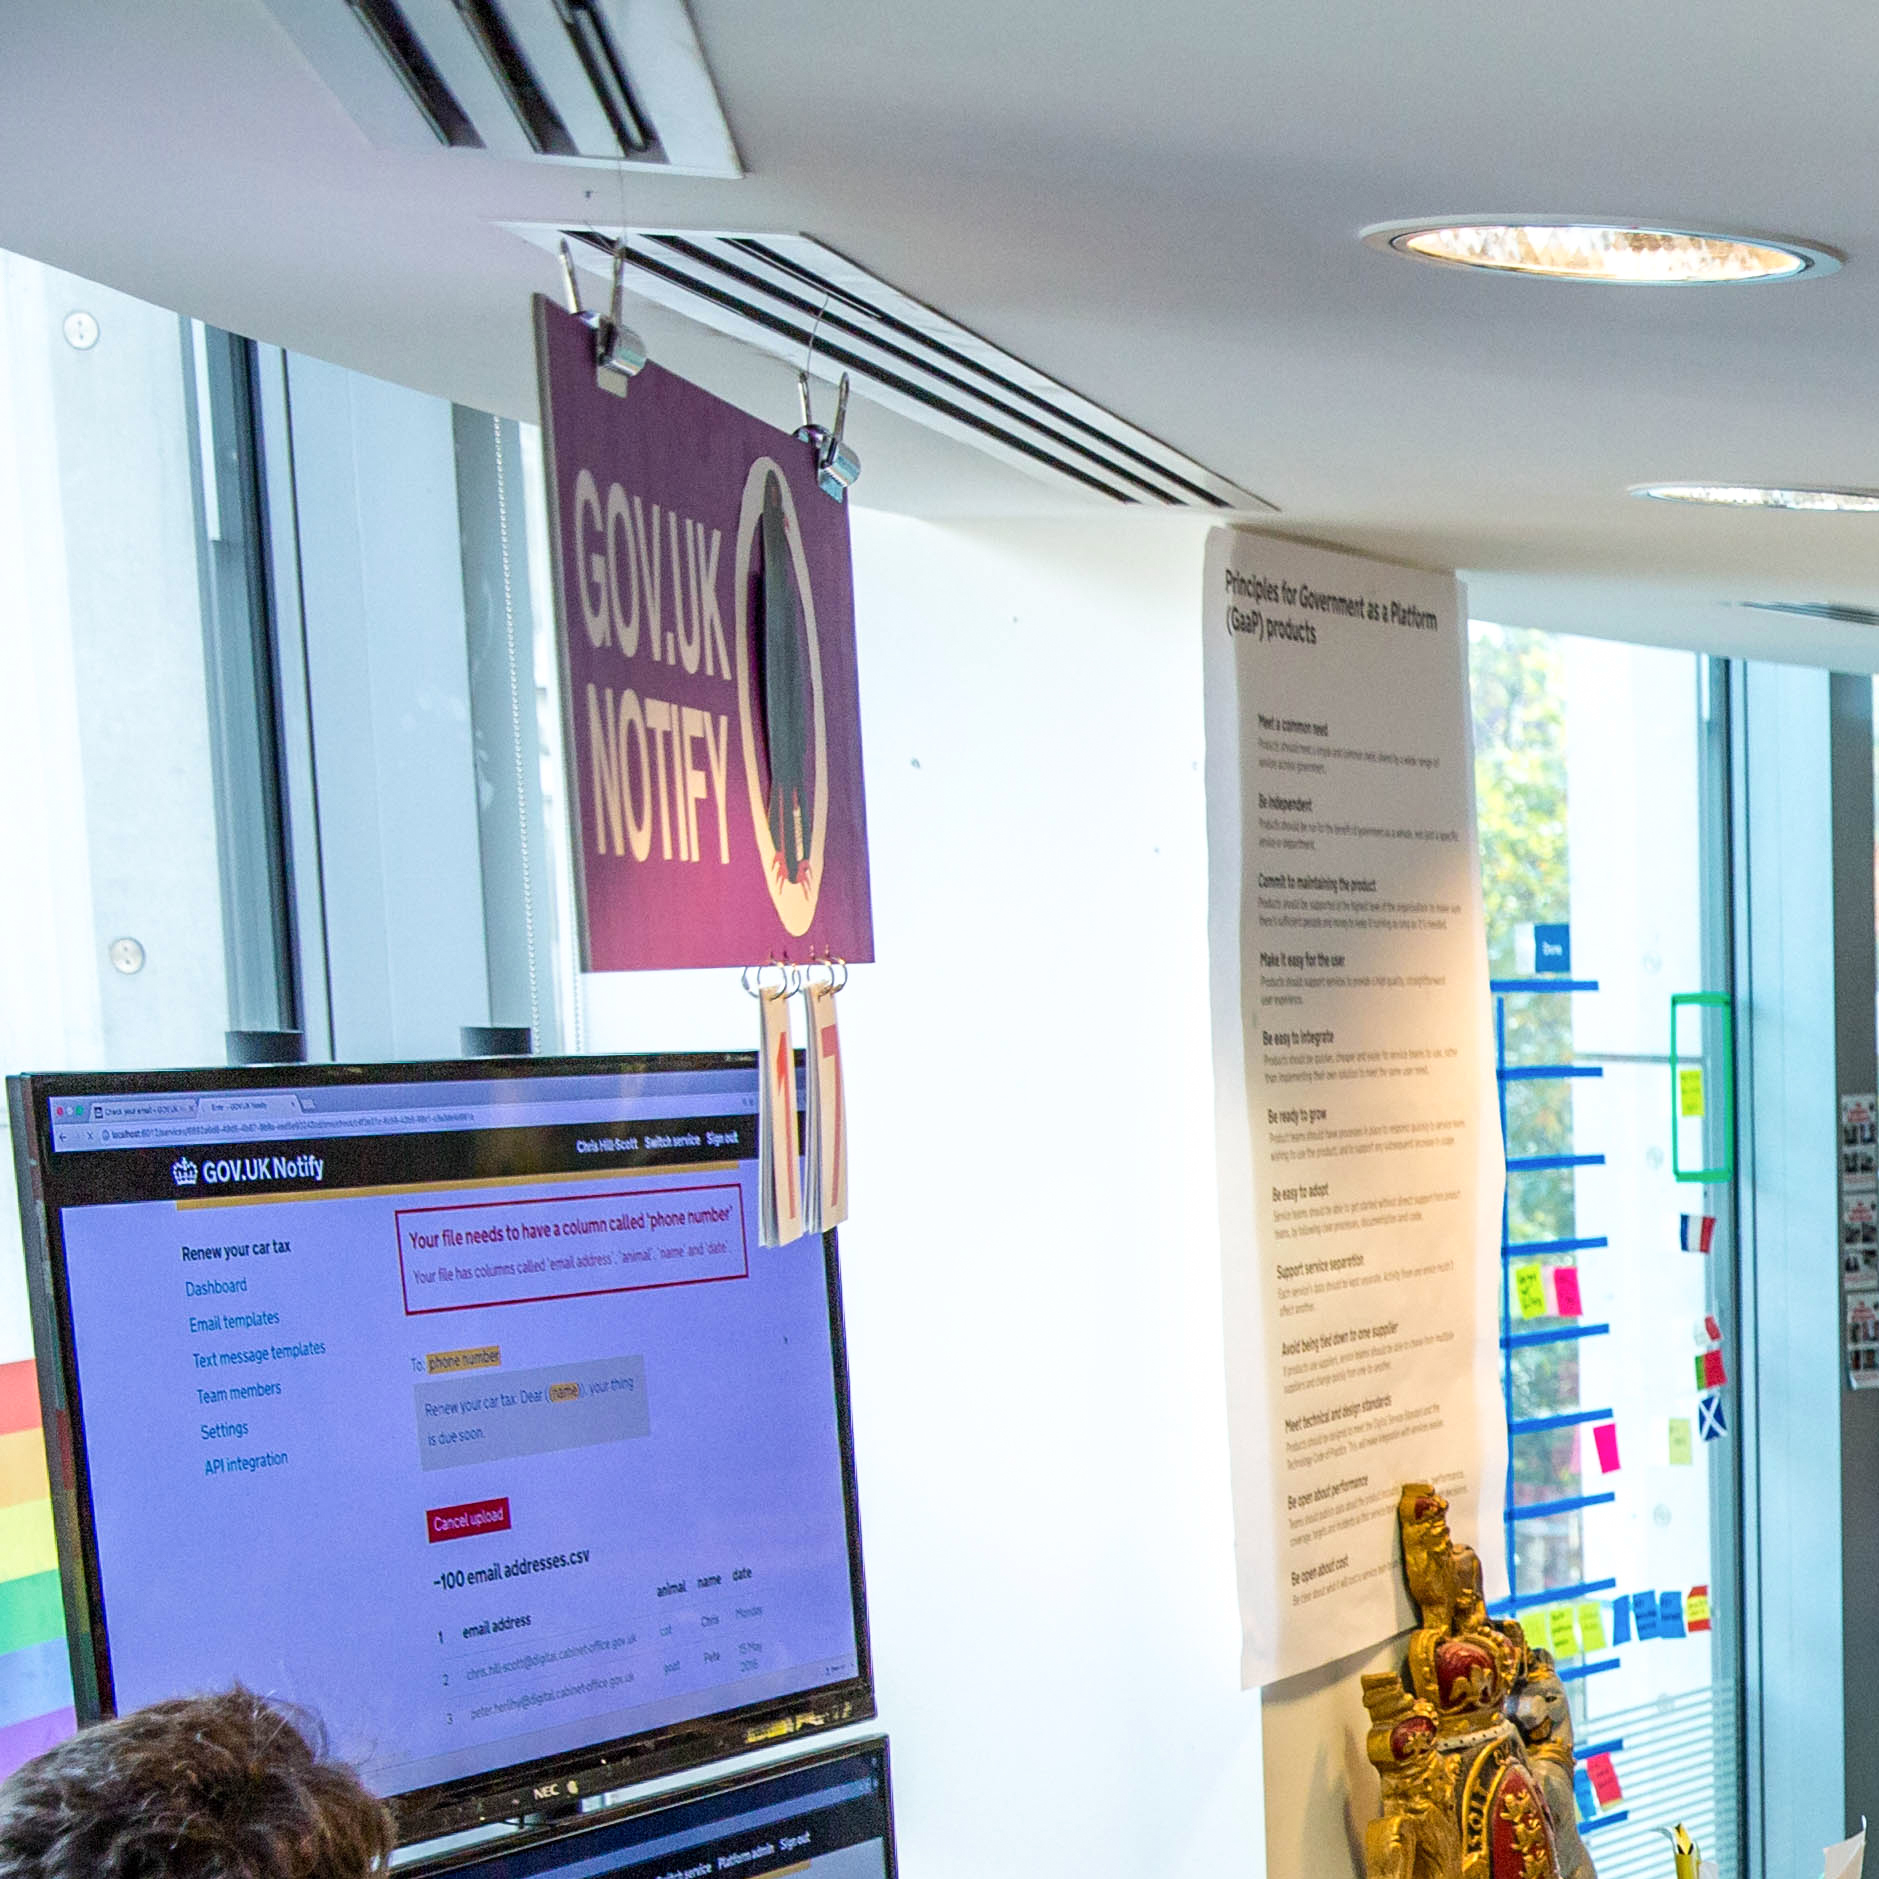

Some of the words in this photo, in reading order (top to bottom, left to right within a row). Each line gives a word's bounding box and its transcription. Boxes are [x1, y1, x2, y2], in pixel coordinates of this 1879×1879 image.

[575, 468, 732, 682] GOV.UK
[1225, 569, 1279, 605] Principles
[1282, 578, 1297, 605] for
[1300, 583, 1364, 619] Government
[1368, 602, 1379, 621] as
[1382, 605, 1388, 622] a
[1390, 600, 1438, 632] Platform
[1226, 606, 1264, 642] (GaaP)
[1266, 614, 1317, 644] products
[586, 682, 730, 865] NOTIFY
[1267, 1109, 1278, 1124] Be
[1279, 1108, 1299, 1126] ready
[1309, 1109, 1327, 1124] grow
[202, 1158, 271, 1184] GOV.UK
[274, 1154, 324, 1181] Notify
[1272, 1187, 1281, 1202] Be
[1308, 1183, 1328, 1199] adopt
[409, 1230, 439, 1250] Your
[442, 1229, 463, 1247] file
[466, 1225, 503, 1244] needs
[506, 1225, 520, 1241] to
[522, 1223, 551, 1240] have
[553, 1225, 561, 1237] a
[563, 1217, 607, 1236] column
[610, 1214, 645, 1232] called
[181, 1246, 221, 1262] Renew
[224, 1244, 249, 1261] your
[252, 1243, 271, 1256] car
[273, 1239, 291, 1253] tax
[414, 1270, 435, 1285] Your
[438, 1267, 454, 1281] file
[455, 1266, 473, 1280] has
[474, 1263, 515, 1279] columns
[516, 1258, 545, 1274] called
[1277, 1262, 1305, 1280] Support
[1305, 1259, 1328, 1275] service
[1329, 1253, 1364, 1271] separation
[185, 1278, 247, 1297] Dashboard
[189, 1315, 222, 1333] Email
[223, 1311, 280, 1329] templates
[193, 1352, 218, 1368] Text
[220, 1348, 269, 1364] message
[271, 1341, 326, 1360] templates
[428, 1356, 461, 1373] phone
[463, 1349, 500, 1365] number
[196, 1388, 228, 1404] Team
[230, 1381, 282, 1400] members
[425, 1402, 459, 1417] Renew
[461, 1399, 483, 1414] your
[484, 1397, 498, 1409] car
[520, 1390, 543, 1404] Dear
[590, 1381, 609, 1396] your
[610, 1377, 634, 1392] thing
[200, 1421, 249, 1440] Settings
[428, 1433, 437, 1446] is
[438, 1431, 457, 1445] due
[205, 1459, 225, 1476] API
[227, 1451, 289, 1472] integration
[1287, 1495, 1296, 1510] Be
[1298, 1492, 1314, 1507] open
[1314, 1484, 1332, 1502] about
[1332, 1475, 1368, 1499] performance
[433, 1513, 469, 1532] Cancel
[471, 1508, 505, 1528] upload
[467, 1563, 503, 1586] email
[504, 1549, 590, 1578] addresses.csv
[1291, 1571, 1300, 1586] Be
[1301, 1569, 1317, 1584] open
[1318, 1561, 1335, 1580] about
[438, 1631, 443, 1644] 1
[462, 1621, 490, 1639] email
[492, 1614, 532, 1633] address
[657, 1580, 687, 1597] animal
[697, 1574, 722, 1588] name
[732, 1568, 752, 1581] date
[442, 1674, 449, 1686] 2
[533, 1783, 560, 1800] NEC
